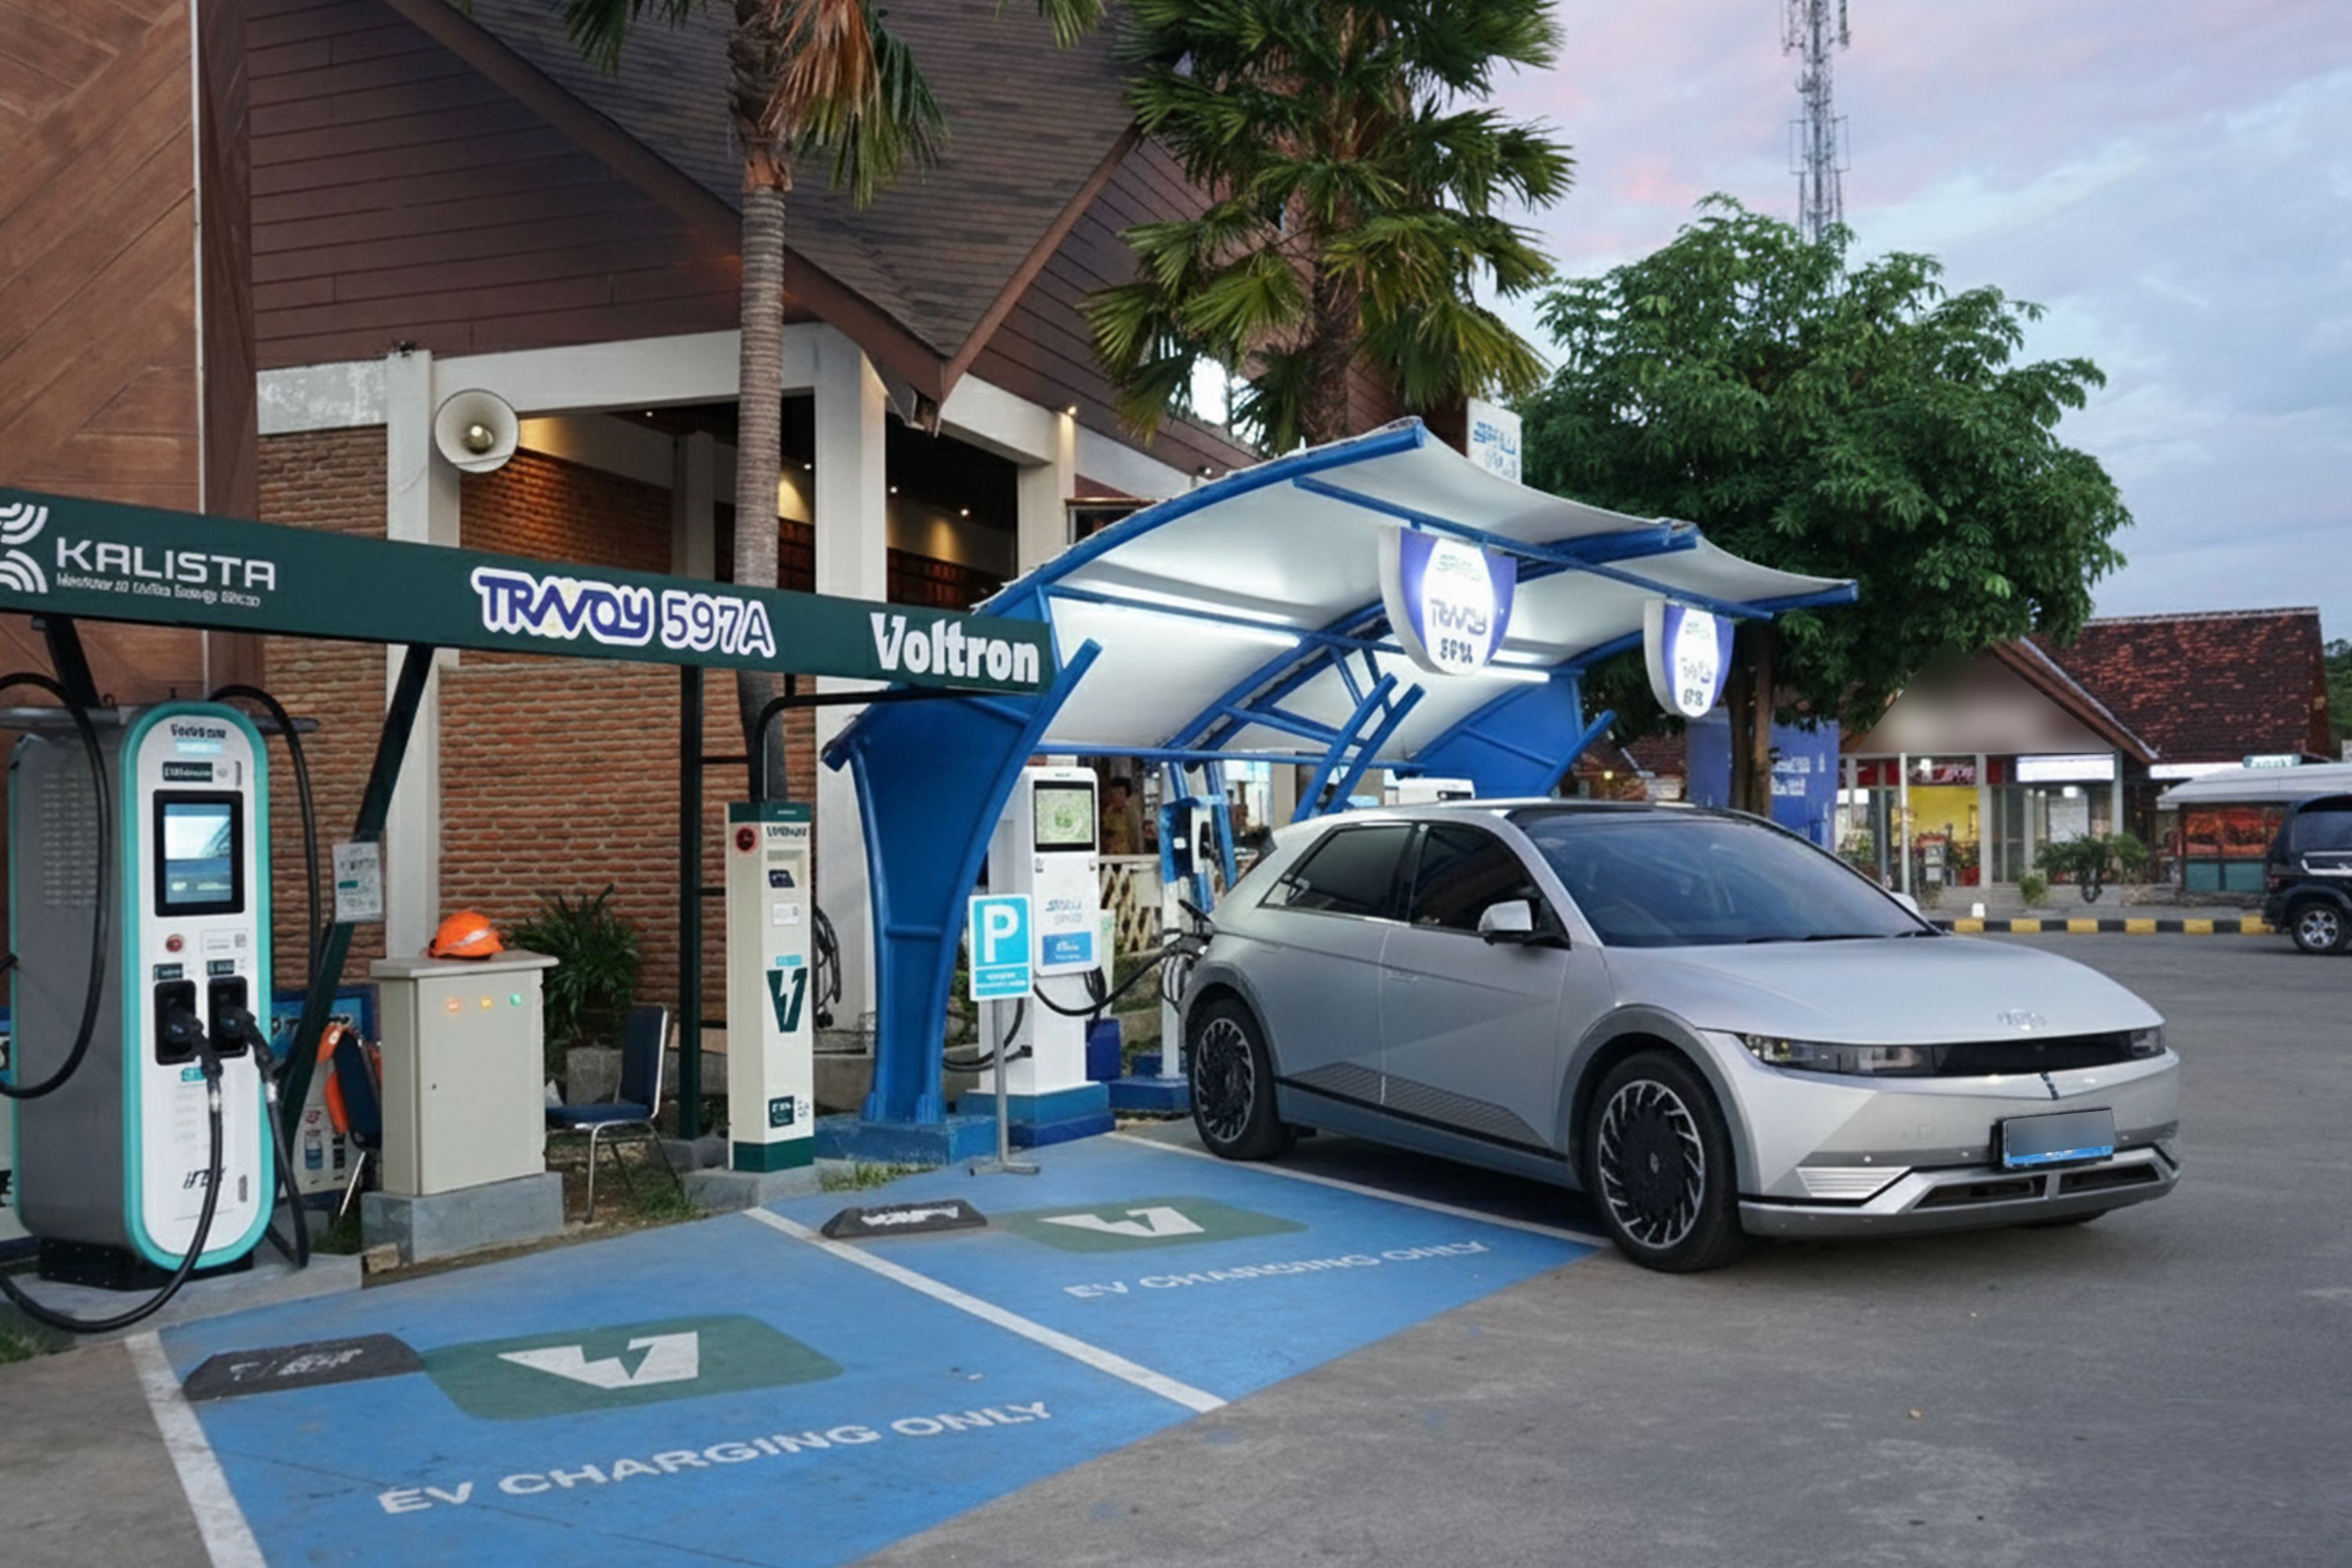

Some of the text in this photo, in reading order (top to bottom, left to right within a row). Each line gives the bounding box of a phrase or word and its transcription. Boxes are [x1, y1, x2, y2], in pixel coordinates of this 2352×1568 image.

[56, 536, 275, 591] KALISTA
[474, 568, 775, 657] TRAVOY 597A
[869, 612, 1040, 684] Voltron
[983, 904, 1020, 964] P
[376, 1400, 1051, 1514] EV CHARGING ONLY
